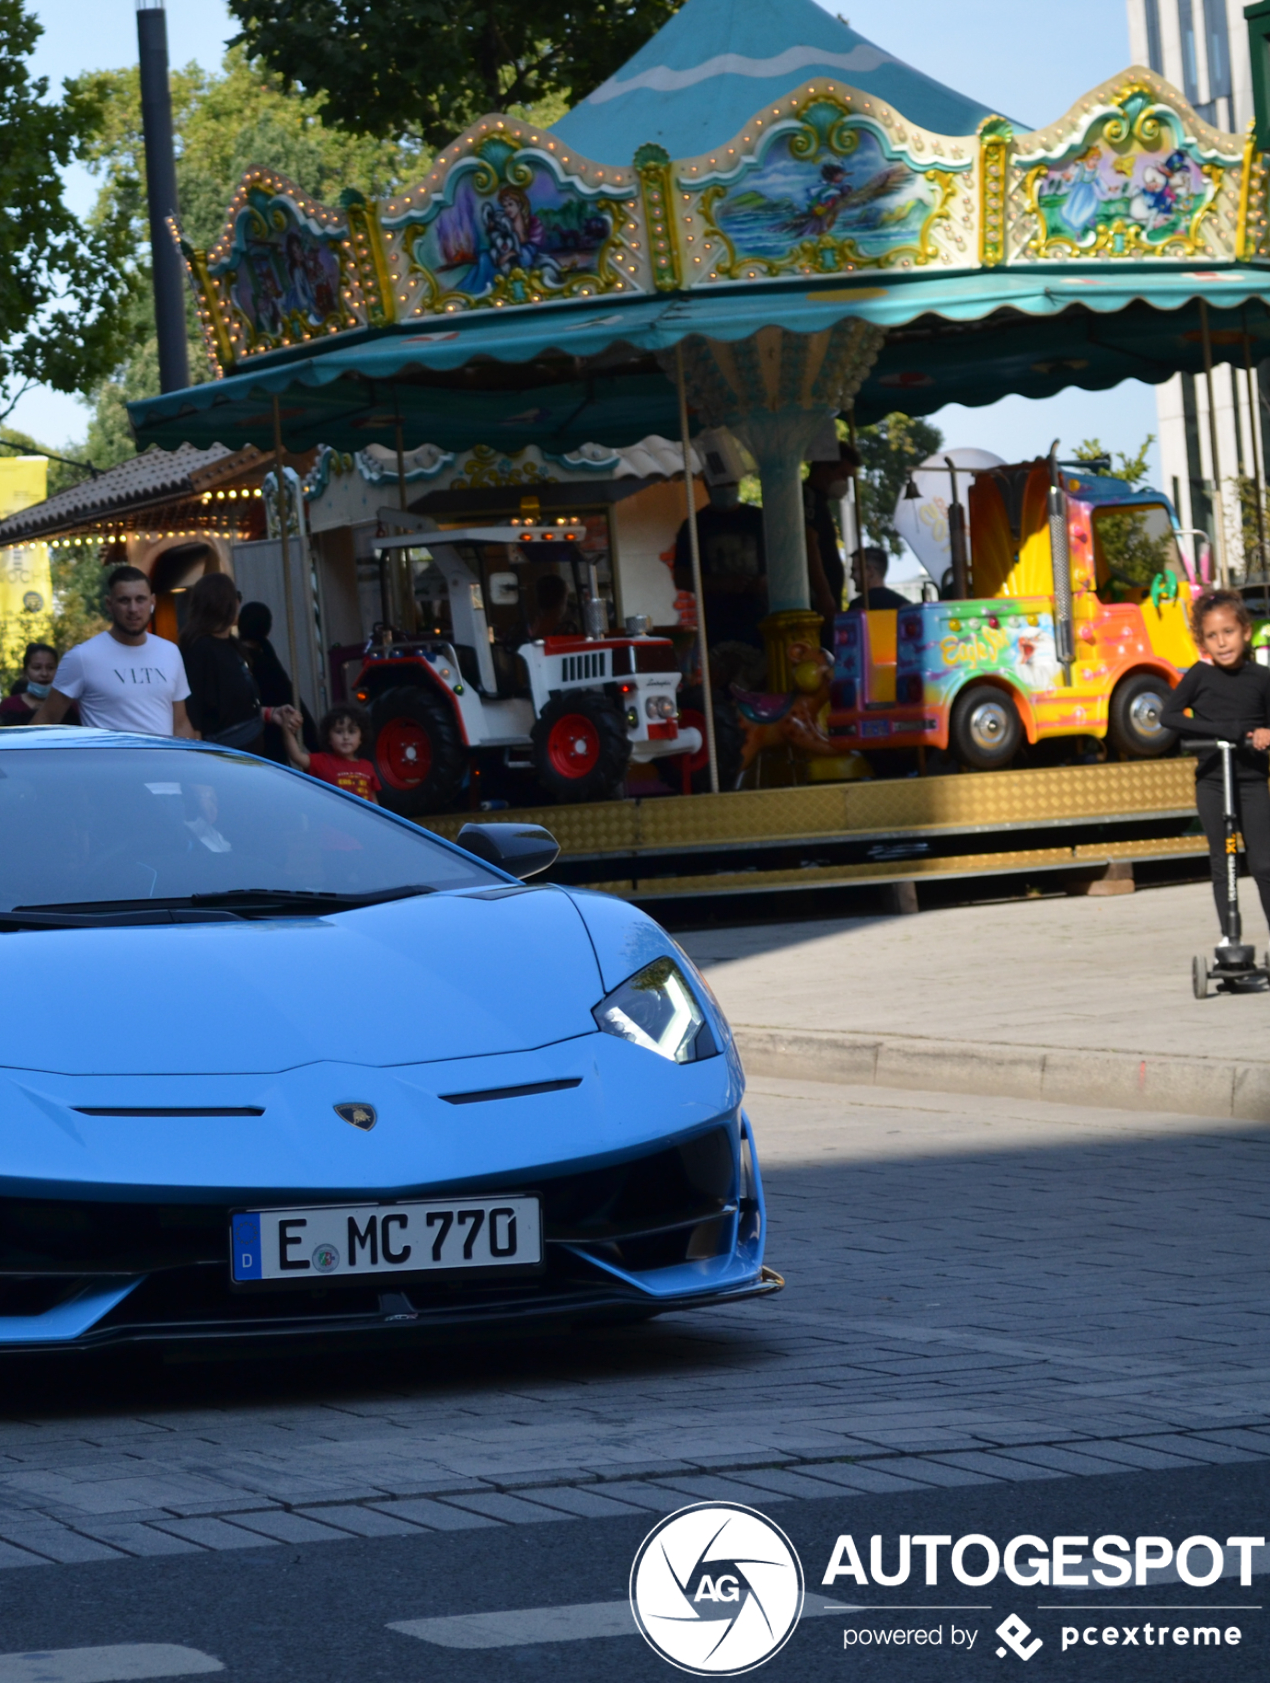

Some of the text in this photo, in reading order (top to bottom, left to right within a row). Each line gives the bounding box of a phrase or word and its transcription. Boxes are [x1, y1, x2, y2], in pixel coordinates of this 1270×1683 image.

[940, 635, 988, 670] Eagle
[113, 667, 168, 685] VLTN
[278, 1207, 518, 1271] E MC 770
[242, 1254, 253, 1268] D
